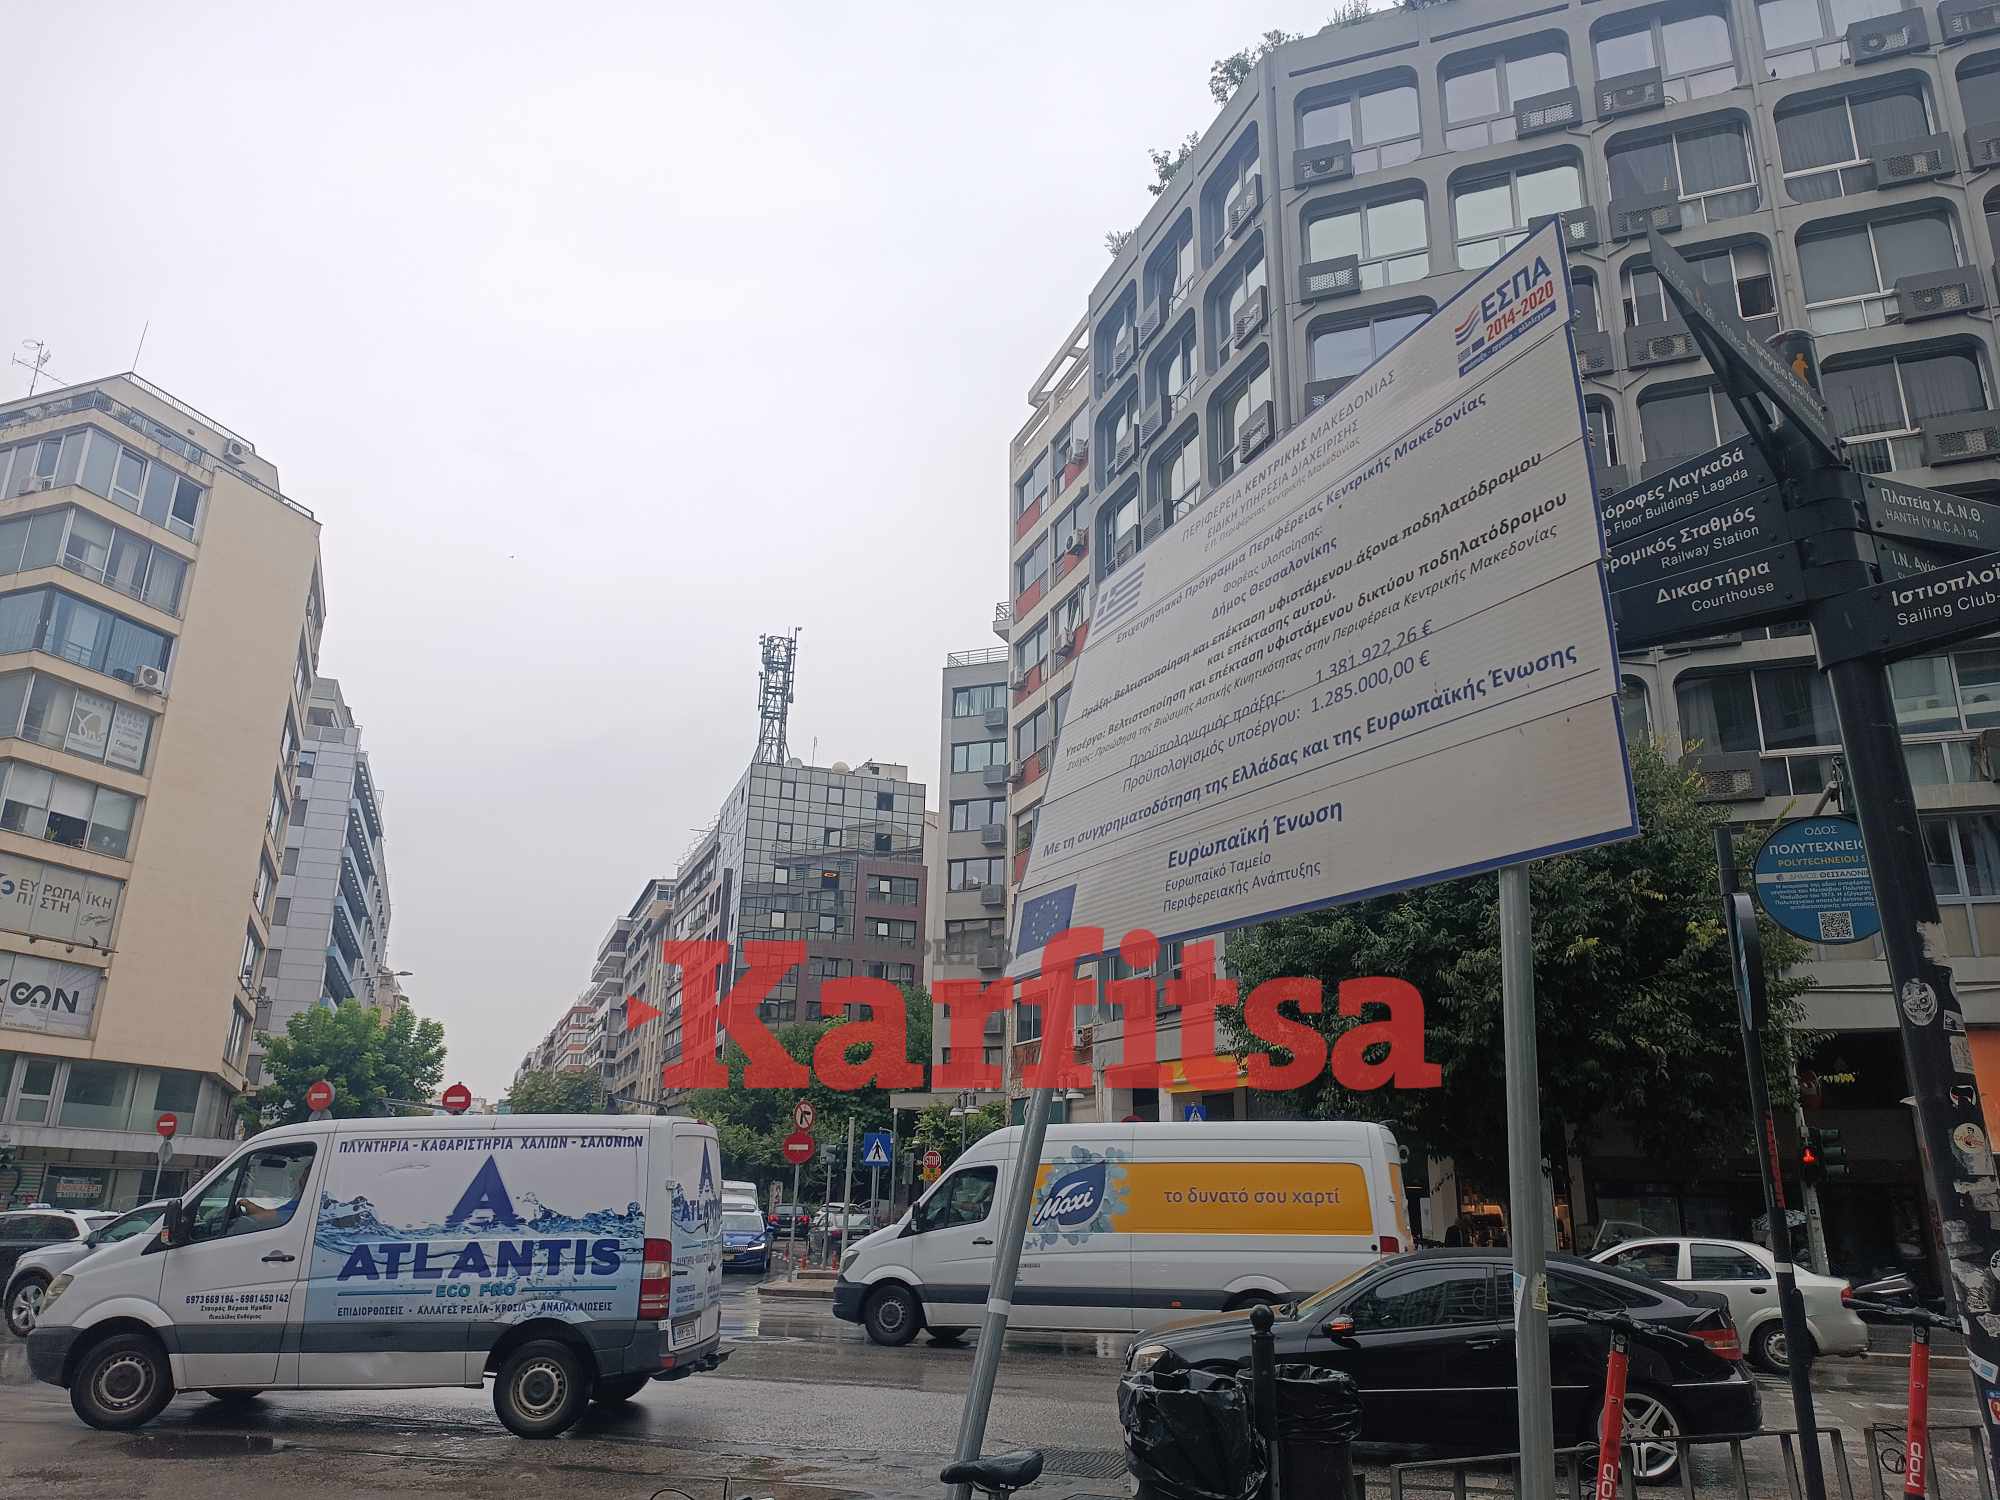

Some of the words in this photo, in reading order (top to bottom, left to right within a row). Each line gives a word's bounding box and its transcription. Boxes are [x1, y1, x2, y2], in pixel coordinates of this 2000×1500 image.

[1481, 255, 1552, 323] ΕΣΠΑ
[1486, 280, 1554, 341] 2014-2020
[1182, 489, 1242, 542] ΠΕΡΙΦΕΡΕΙΑ
[1244, 438, 1307, 494] ΚΕΝΤΡΙΚΗΣ
[1309, 369, 1396, 445] ΜΑΚΕΔΟΝΙΑΣ
[1667, 448, 1745, 493] Λαγκαδά
[1185, 553, 1246, 600] Πρόγραμμα
[1250, 502, 1324, 556] Περιφέρειας
[1326, 454, 1391, 504] Κεντρικής
[1394, 393, 1487, 461] Μακεδονίας
[1207, 508, 1238, 539] ΕΙΔΙΚΗ
[1240, 474, 1289, 518] ΥΠΗΡΕΣΙΑ
[1291, 418, 1359, 477] ΔΙΑΧΕΙΡΙΣΗΣ
[1614, 514, 1642, 534] Floor
[1646, 488, 1699, 521] Buildings
[1702, 466, 1749, 495] Lagada
[1680, 506, 1757, 544] Σταθμός
[1880, 487, 1931, 511] Πλατεία
[1933, 499, 1985, 524] Χ.Α.Ν.Θ.
[1885, 509, 1919, 524] HANTH
[1223, 567, 1259, 594] Φορέας
[1261, 526, 1323, 572] υλοποίησης:
[1661, 542, 1710, 570] Railway
[1713, 526, 1760, 550] Station
[1114, 653, 1190, 700] Βελτιστοποίηση
[1193, 642, 1210, 657] και
[1212, 609, 1265, 647] επέκταση
[1269, 560, 1352, 616] υφιστάμενου
[1356, 534, 1398, 566] άξονα
[1402, 453, 1542, 540] ποδηλατόδρομου
[1211, 591, 1247, 620] Δήμος
[1250, 537, 1337, 597] Θεσσαλονίκης
[1656, 561, 1771, 604] Δικαστήρια
[1691, 581, 1775, 612] Courthouse
[1108, 687, 1186, 735] Βελτιστοποίηση
[1188, 678, 1206, 695] και
[1208, 647, 1264, 684] επέκταση
[1267, 602, 1353, 654] υφιστάμενου
[1357, 571, 1414, 607] δικτύου
[1418, 493, 1568, 577] ποδηλατόδρομου
[1197, 685, 1232, 709] Αστικής
[1234, 648, 1302, 689] Κινητικότητας
[1305, 633, 1330, 656] στην
[1333, 600, 1400, 643] Περιφέρεια
[1403, 567, 1466, 608] Κεντρικής
[1470, 525, 1558, 575] Μακεδονίας
[1207, 651, 1225, 667] και
[1227, 614, 1290, 659] επέκτασης
[1292, 589, 1337, 620] αυτού.
[1897, 604, 1953, 626] Sailing
[1312, 657, 1414, 713] 1.285.000,00
[1420, 650, 1431, 667] €
[1043, 841, 1062, 857] Με
[1063, 837, 1075, 852] τη
[1077, 785, 1201, 845] συγχρηματοδότηση
[1204, 775, 1229, 795] της
[1232, 749, 1298, 785] Ελλάδας
[1302, 740, 1329, 761] και
[1332, 726, 1362, 746] της
[1366, 678, 1487, 736] Ευρωπαϊκής
[1487, 644, 1577, 689] Ένωσης
[1122, 738, 1225, 792] Προϋπολογισμός
[1228, 708, 1301, 748] υποέργου:
[1167, 820, 1270, 869] Ευρωπαϊκή
[1272, 801, 1344, 838] Ένωση
[1804, 825, 1840, 836] ΟΔΟΣ
[1164, 864, 1227, 893] Ευρωπαϊκό
[1229, 852, 1272, 875] Ταμείο
[1777, 855, 1858, 868] POLYTECHNEIOU
[16, 890, 70, 914] ΠΙΣΤΗ
[18, 878, 113, 910] ΕΥΡΩΠΑΪΚΗ
[1163, 880, 1250, 913] Περιφερειακής
[1251, 860, 1322, 890] Ανάπτυξης
[339, 1139, 409, 1153] ΠΛΥΝΤΗΡΙΑ
[421, 1137, 513, 1151] ΚΑΘΑΡΙΣΤΗΡΙΑ
[520, 1136, 568, 1149] ΧΑΛΙΩΝ
[580, 1135, 643, 1148] ΣΑΛΟΝΙΩΝ
[925, 1156, 940, 1166] STOP
[1164, 1189, 1182, 1204] το
[1187, 1187, 1248, 1205] δυνατό
[1254, 1190, 1287, 1204] σου
[1291, 1186, 1340, 1207] χαρτί
[337, 1238, 622, 1282] ATLANTIS
[337, 1305, 404, 1317] ΕΠΙΔΙΟΡΘΩΣΕΙΣ
[417, 1304, 458, 1315] ΑΛΛΑΓΕΣ
[435, 1284, 471, 1298] ECO
[479, 1282, 517, 1297] PRO
[1907, 1441, 1923, 1488] hop
